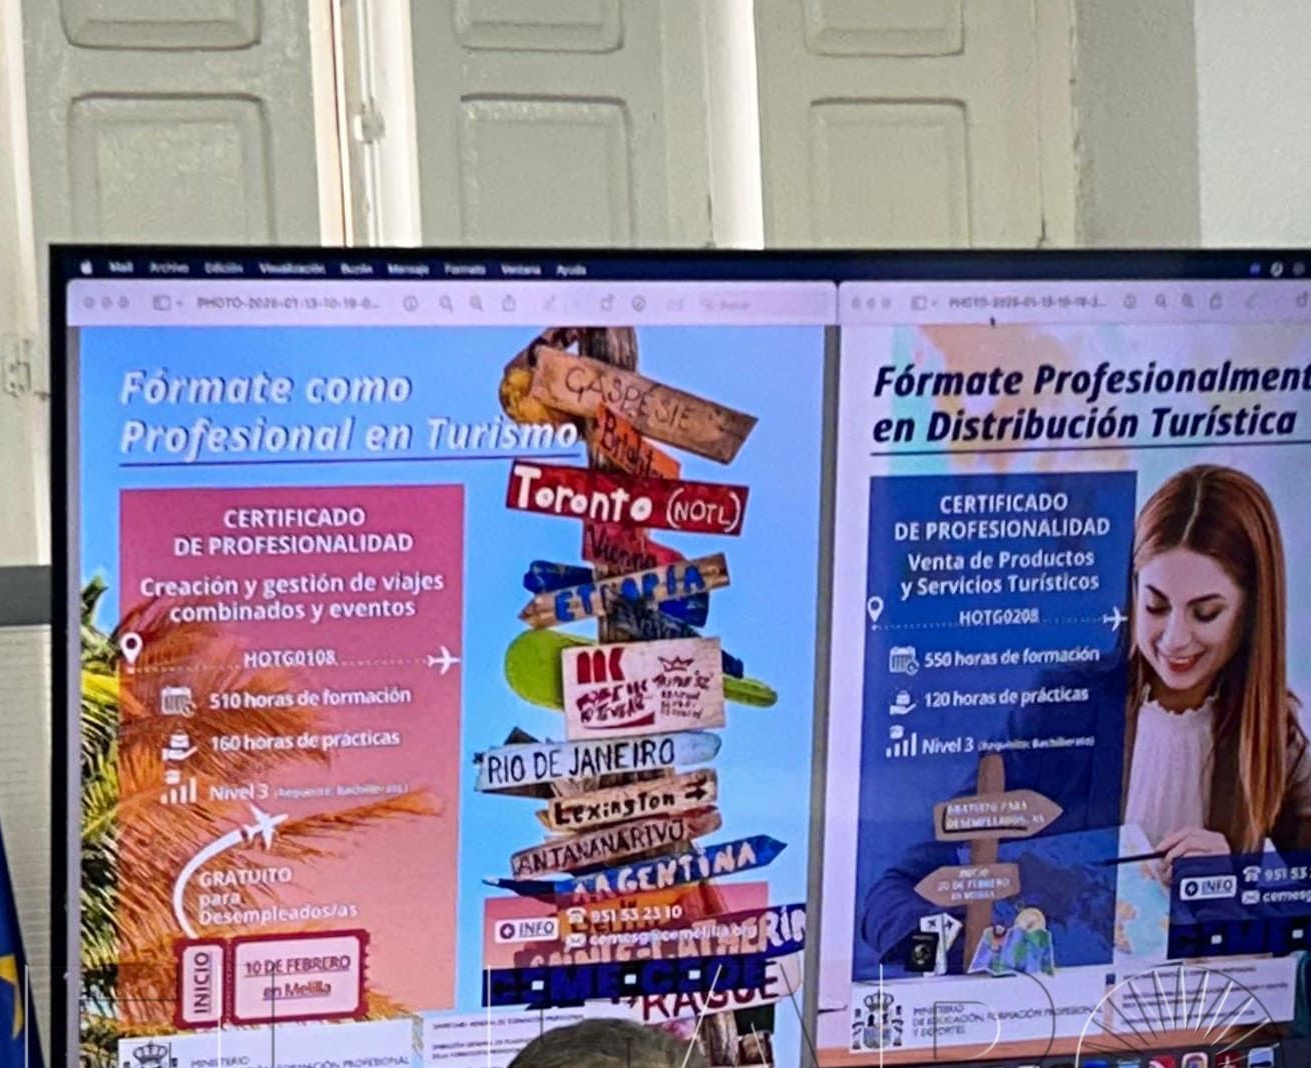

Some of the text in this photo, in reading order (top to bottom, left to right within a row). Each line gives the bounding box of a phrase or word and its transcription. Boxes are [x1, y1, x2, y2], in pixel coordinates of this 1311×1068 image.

[120, 368, 412, 406] Fórmate como
[874, 366, 1022, 398] Fórmate
[873, 404, 1297, 443] en Distribución Turística
[120, 413, 580, 463] Profesional en Turismo
[513, 464, 653, 522] Toronto
[939, 492, 1069, 514] CERTIFICADO
[223, 508, 366, 530] CERTIFICADO
[895, 518, 1110, 541] DE PROFESIONALIDAD
[174, 533, 414, 557] DE PROFESIONALIDAD
[908, 548, 1095, 573] Venta de Productos
[140, 571, 445, 601] Creación y gestión de viajes
[901, 570, 1100, 600] y Servicios Turísticos
[169, 600, 416, 625] combinados y eventos
[244, 650, 337, 669] HOTG0108
[924, 646, 1101, 668] 550 horas de formación
[209, 685, 412, 709] 510 horas de formación
[924, 686, 1090, 708] 120 horas de prácticas
[243, 732, 293, 751] horas
[296, 731, 319, 749] de
[321, 728, 401, 753] prácticas
[922, 736, 962, 754] Nivel
[964, 736, 975, 752] 3
[487, 737, 675, 784] RIO DE JANEIRO
[209, 784, 255, 801] Nivel
[258, 784, 270, 800] 3
[200, 867, 293, 888] GRATUITO
[1201, 879, 1234, 895] INFO
[199, 891, 240, 908] para
[199, 902, 359, 925] Desempleados/as
[519, 920, 556, 939] INFO
[245, 955, 351, 975] 10 DE FEBRERO
[193, 951, 212, 1014] INICIO
[263, 980, 332, 999] en Melilla
